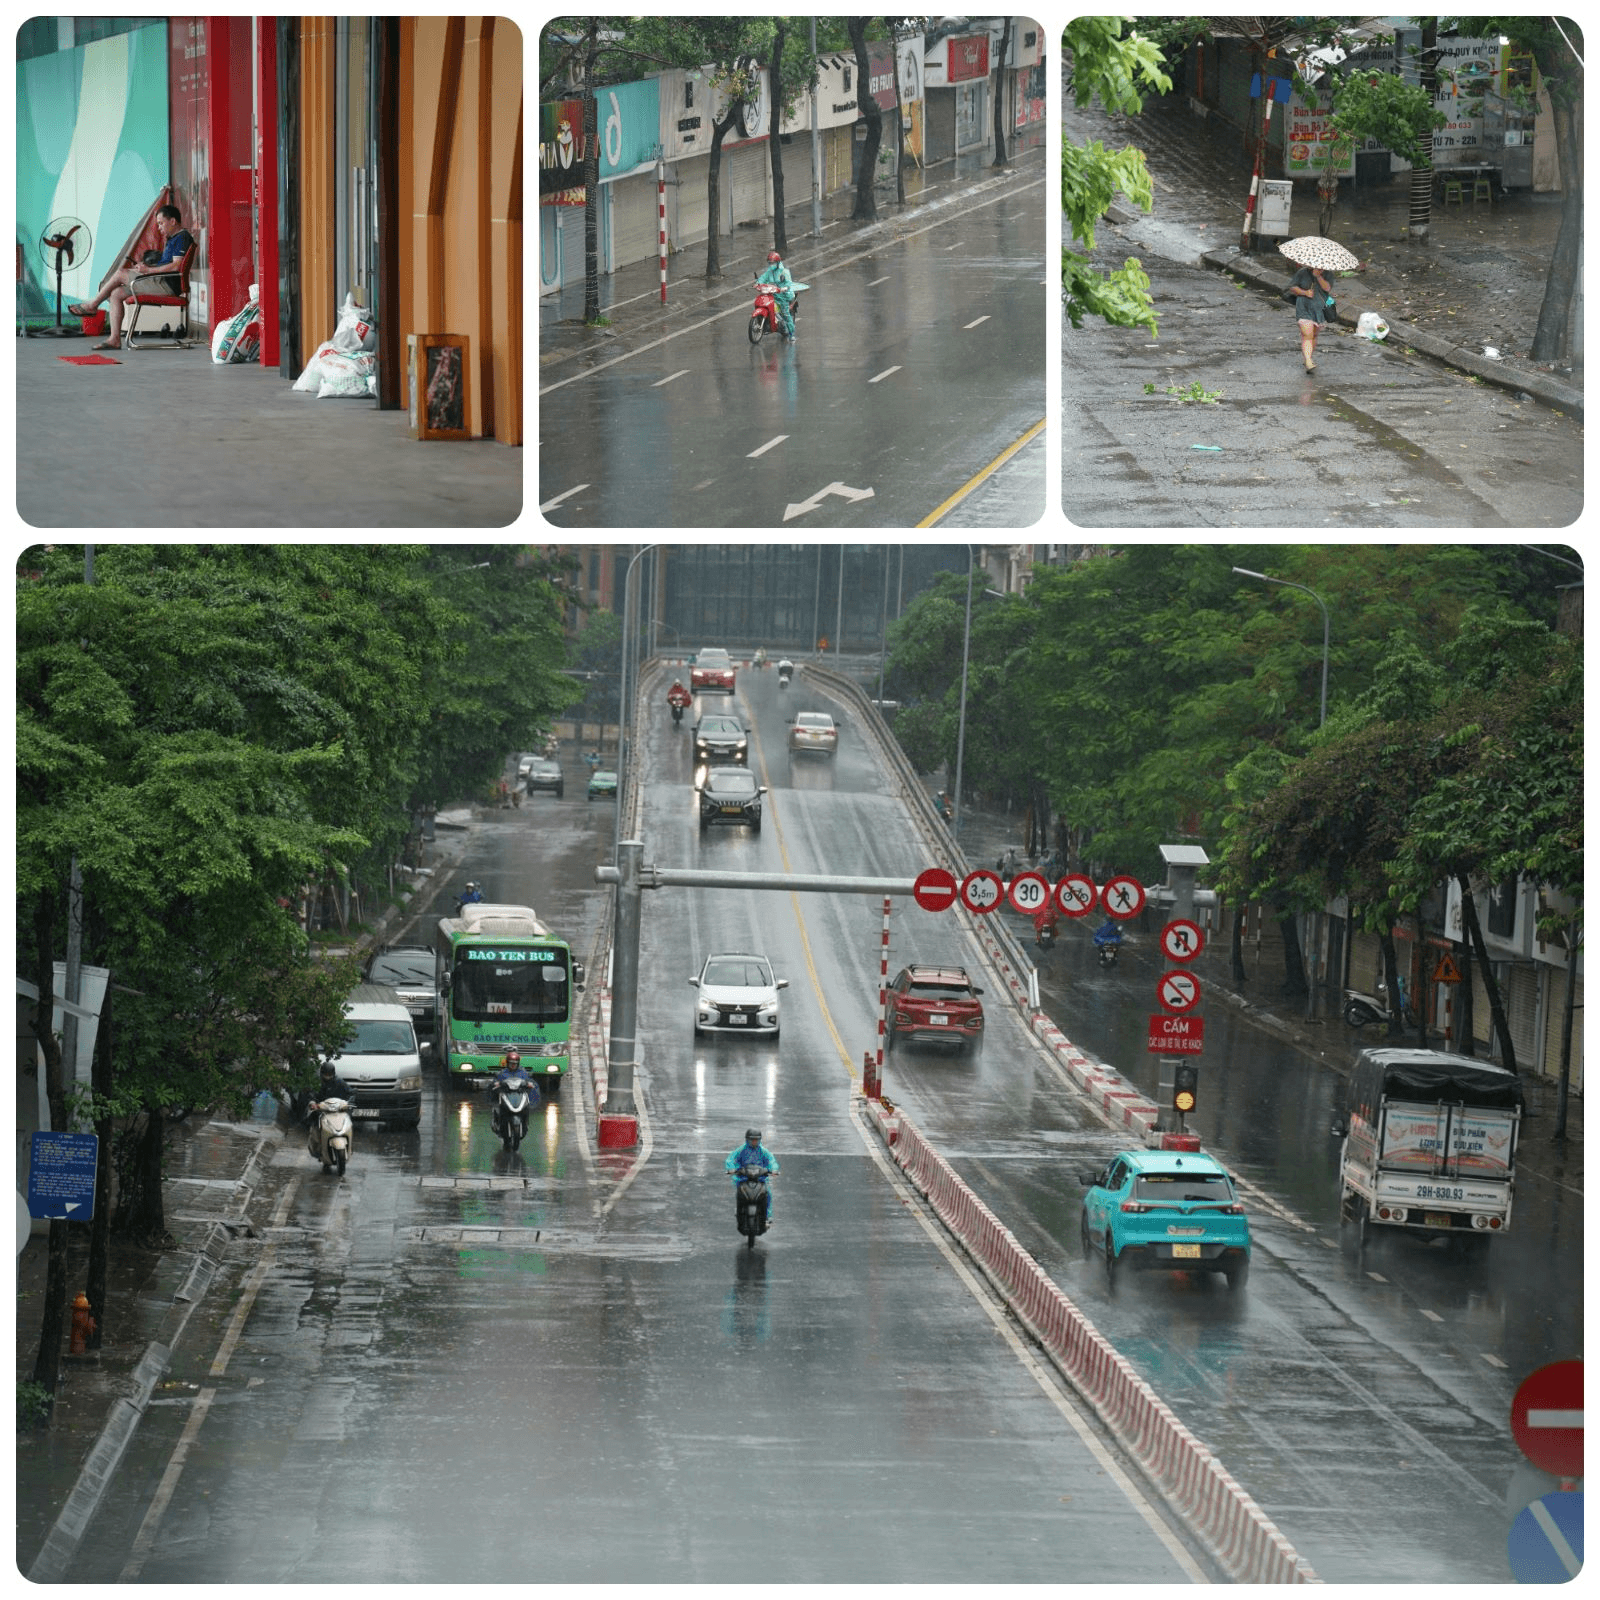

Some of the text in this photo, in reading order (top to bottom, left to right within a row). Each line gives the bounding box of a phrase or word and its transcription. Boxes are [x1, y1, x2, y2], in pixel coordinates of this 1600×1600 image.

[1445, 136, 1454, 146] 7h
[1461, 136, 1477, 145] 22h
[970, 883, 995, 900] 3,5m
[1019, 883, 1039, 902] 30
[468, 950, 555, 961] BAO YEN BUS
[1163, 1017, 1189, 1034] CẤM
[473, 1034, 491, 1042] BAO
[531, 1035, 547, 1043] BUS
[1416, 1185, 1464, 1200] 29H-830.93
